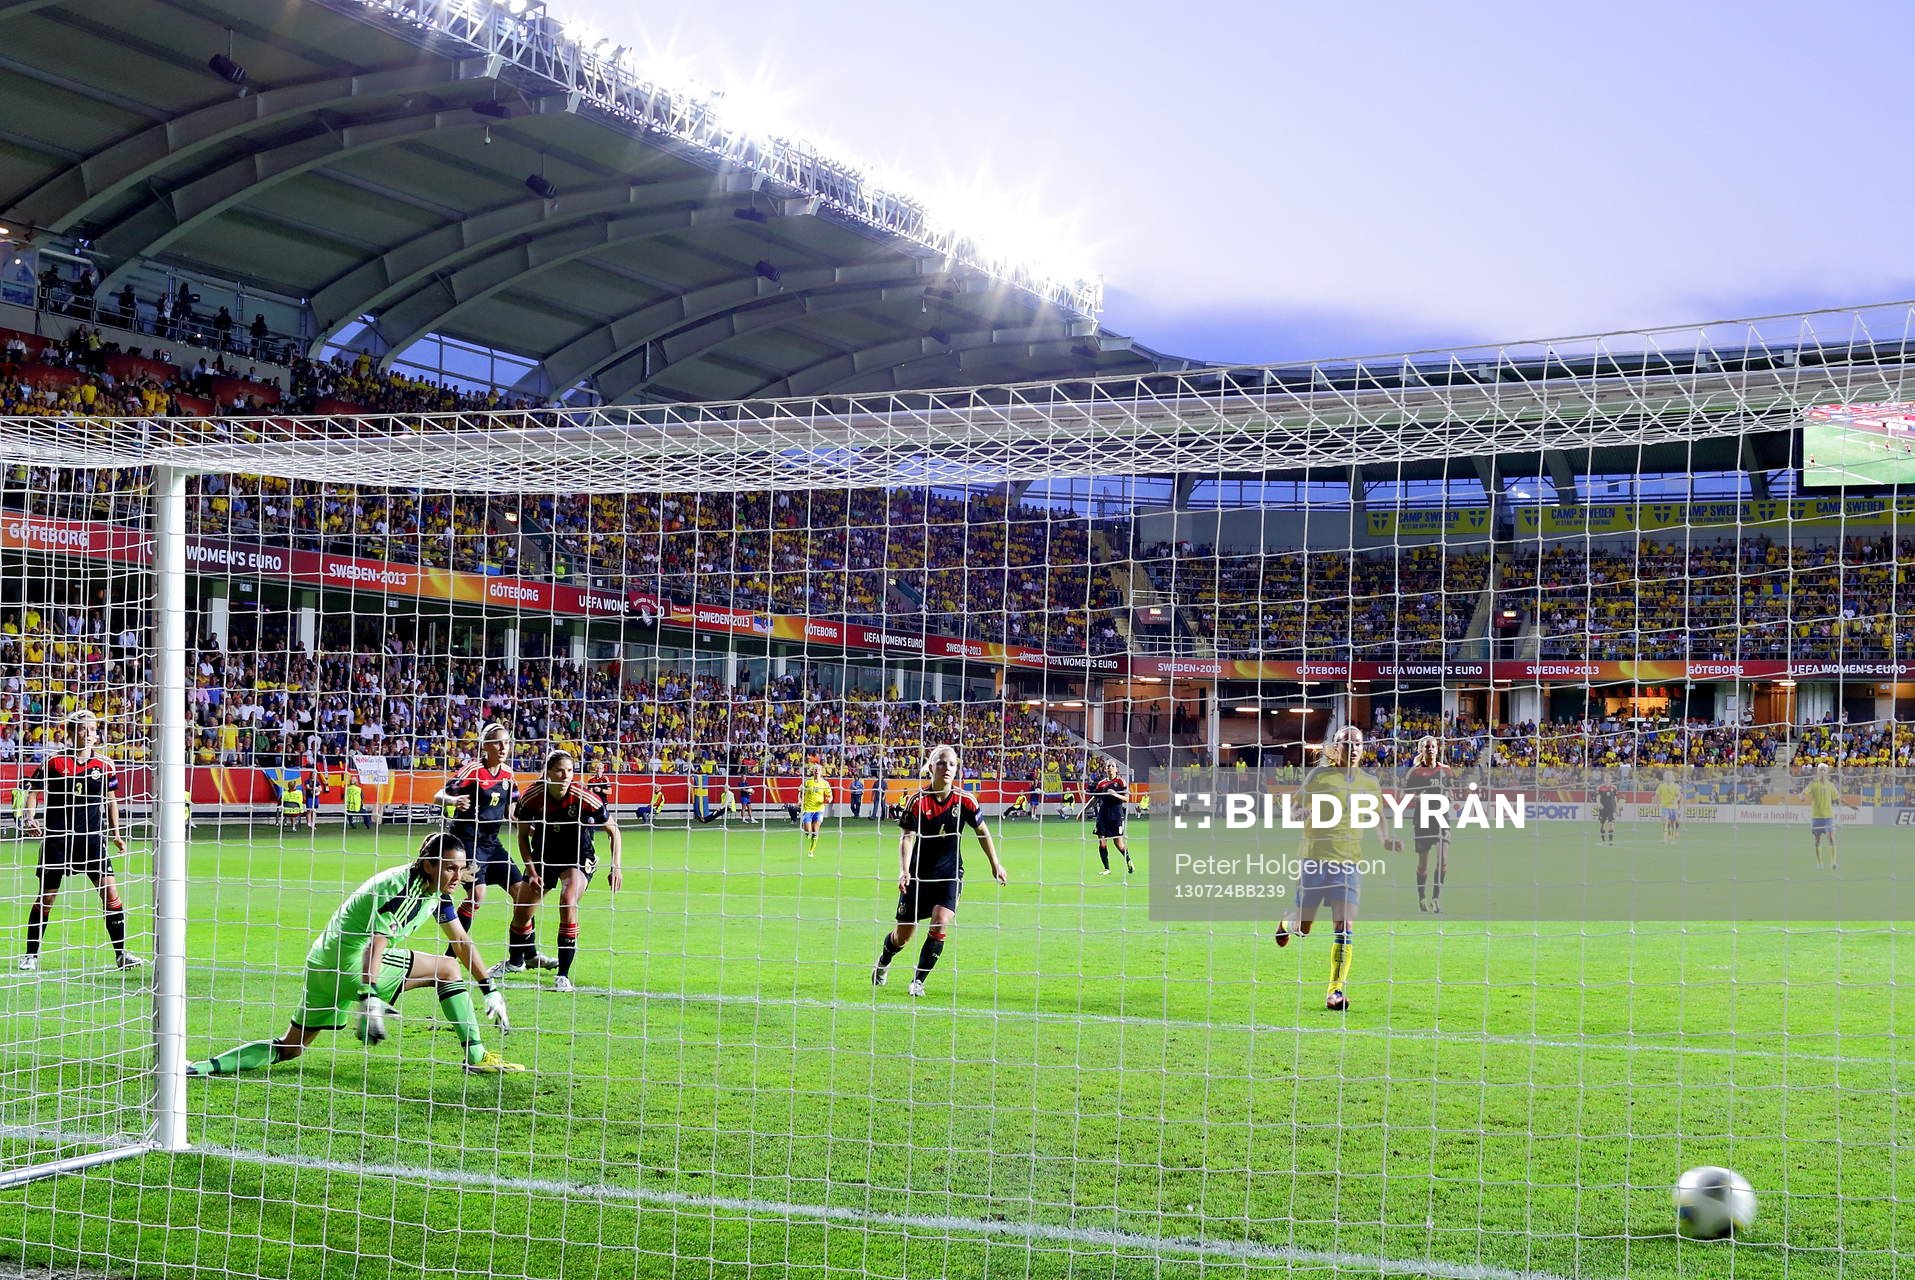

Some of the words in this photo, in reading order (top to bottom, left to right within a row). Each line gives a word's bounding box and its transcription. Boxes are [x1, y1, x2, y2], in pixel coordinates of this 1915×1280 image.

[1551, 508, 1577, 519] CAMP
[1579, 507, 1616, 519] SWEDEN
[1710, 504, 1750, 516] SWEDEN
[9, 522, 89, 547] GÖTEBORG
[186, 545, 246, 567] WOMEN'S
[248, 553, 282, 571] EURO
[490, 582, 539, 601] GÖTEBORG
[578, 595, 602, 609] UEFA
[699, 611, 750, 627] SWEDEN2013
[863, 632, 880, 643] UEFA
[908, 637, 923, 649] EURO
[1063, 657, 1097, 668] WOMEN'S
[1098, 660, 1118, 669] EURO
[1296, 665, 1347, 675] GÖTEBORG
[1378, 666, 1405, 675] UEFA
[1406, 666, 1453, 675] WOMEN'S
[1455, 666, 1483, 675] EURO
[1687, 664, 1744, 675] GÖTEBORG
[1790, 665, 1819, 675] UEFA
[1821, 665, 1872, 674] WOMEN'S
[1875, 665, 1907, 674] EURO
[75, 782, 83, 796] 3
[490, 793, 500, 806] 15
[1685, 807, 1718, 819] SPORT
[1741, 811, 1762, 819] Make
[1771, 811, 1799, 821] healthy
[1840, 811, 1857, 821] goal
